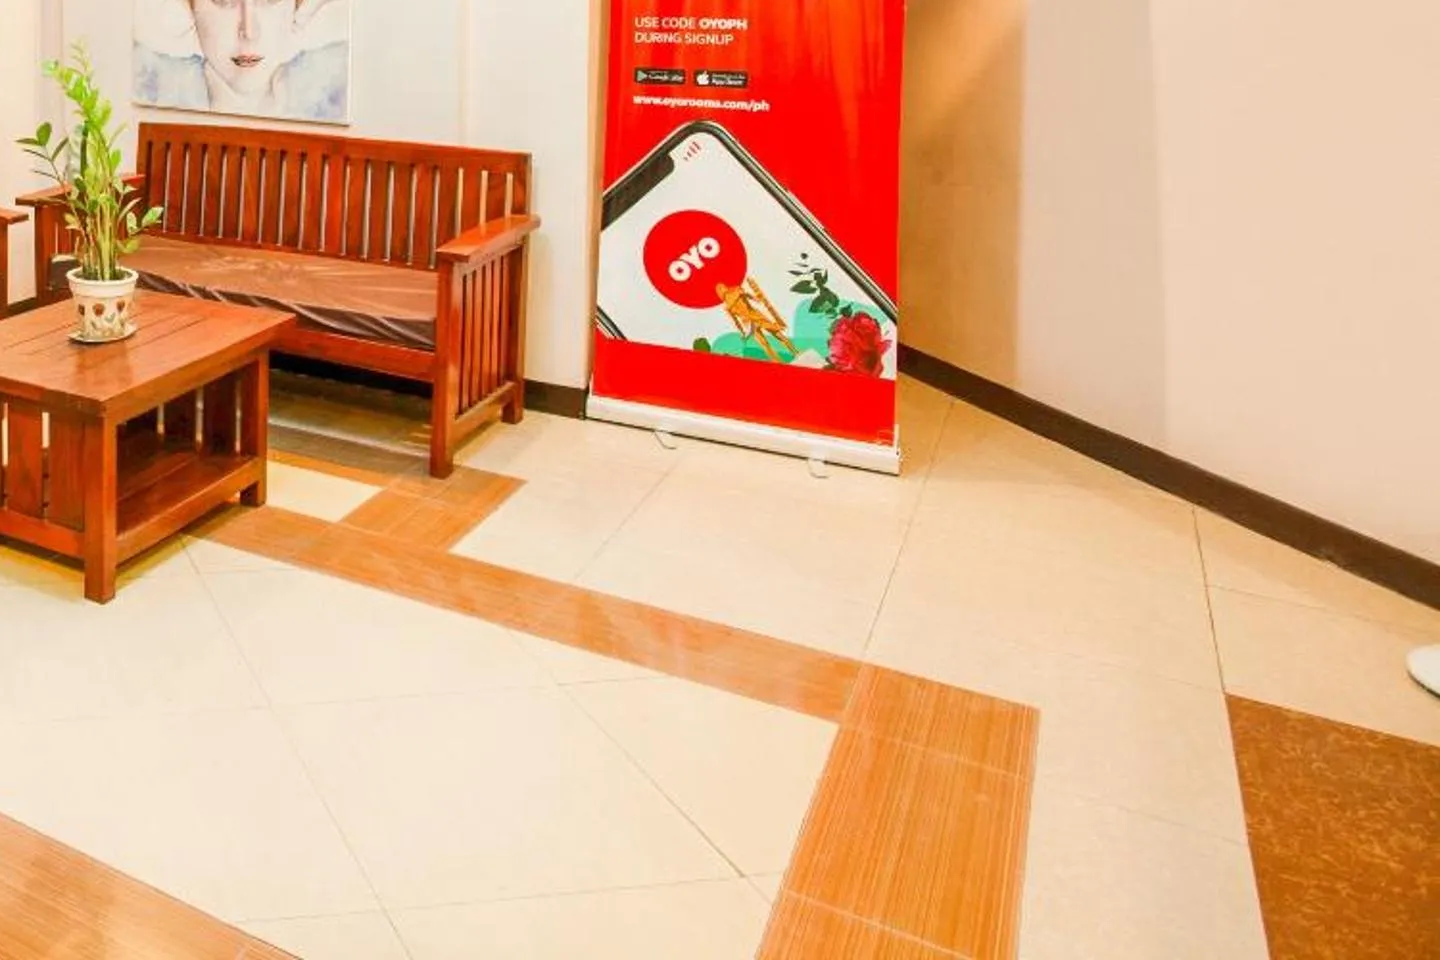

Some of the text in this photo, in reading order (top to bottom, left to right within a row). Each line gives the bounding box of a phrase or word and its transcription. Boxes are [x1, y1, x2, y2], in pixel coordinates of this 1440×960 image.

[635, 17, 748, 30] USE CODE OYOPH
[634, 32, 734, 45] DURING SIGNUP
[633, 95, 770, 113] www.oyorooms.com/ph
[667, 236, 721, 282] OYO
